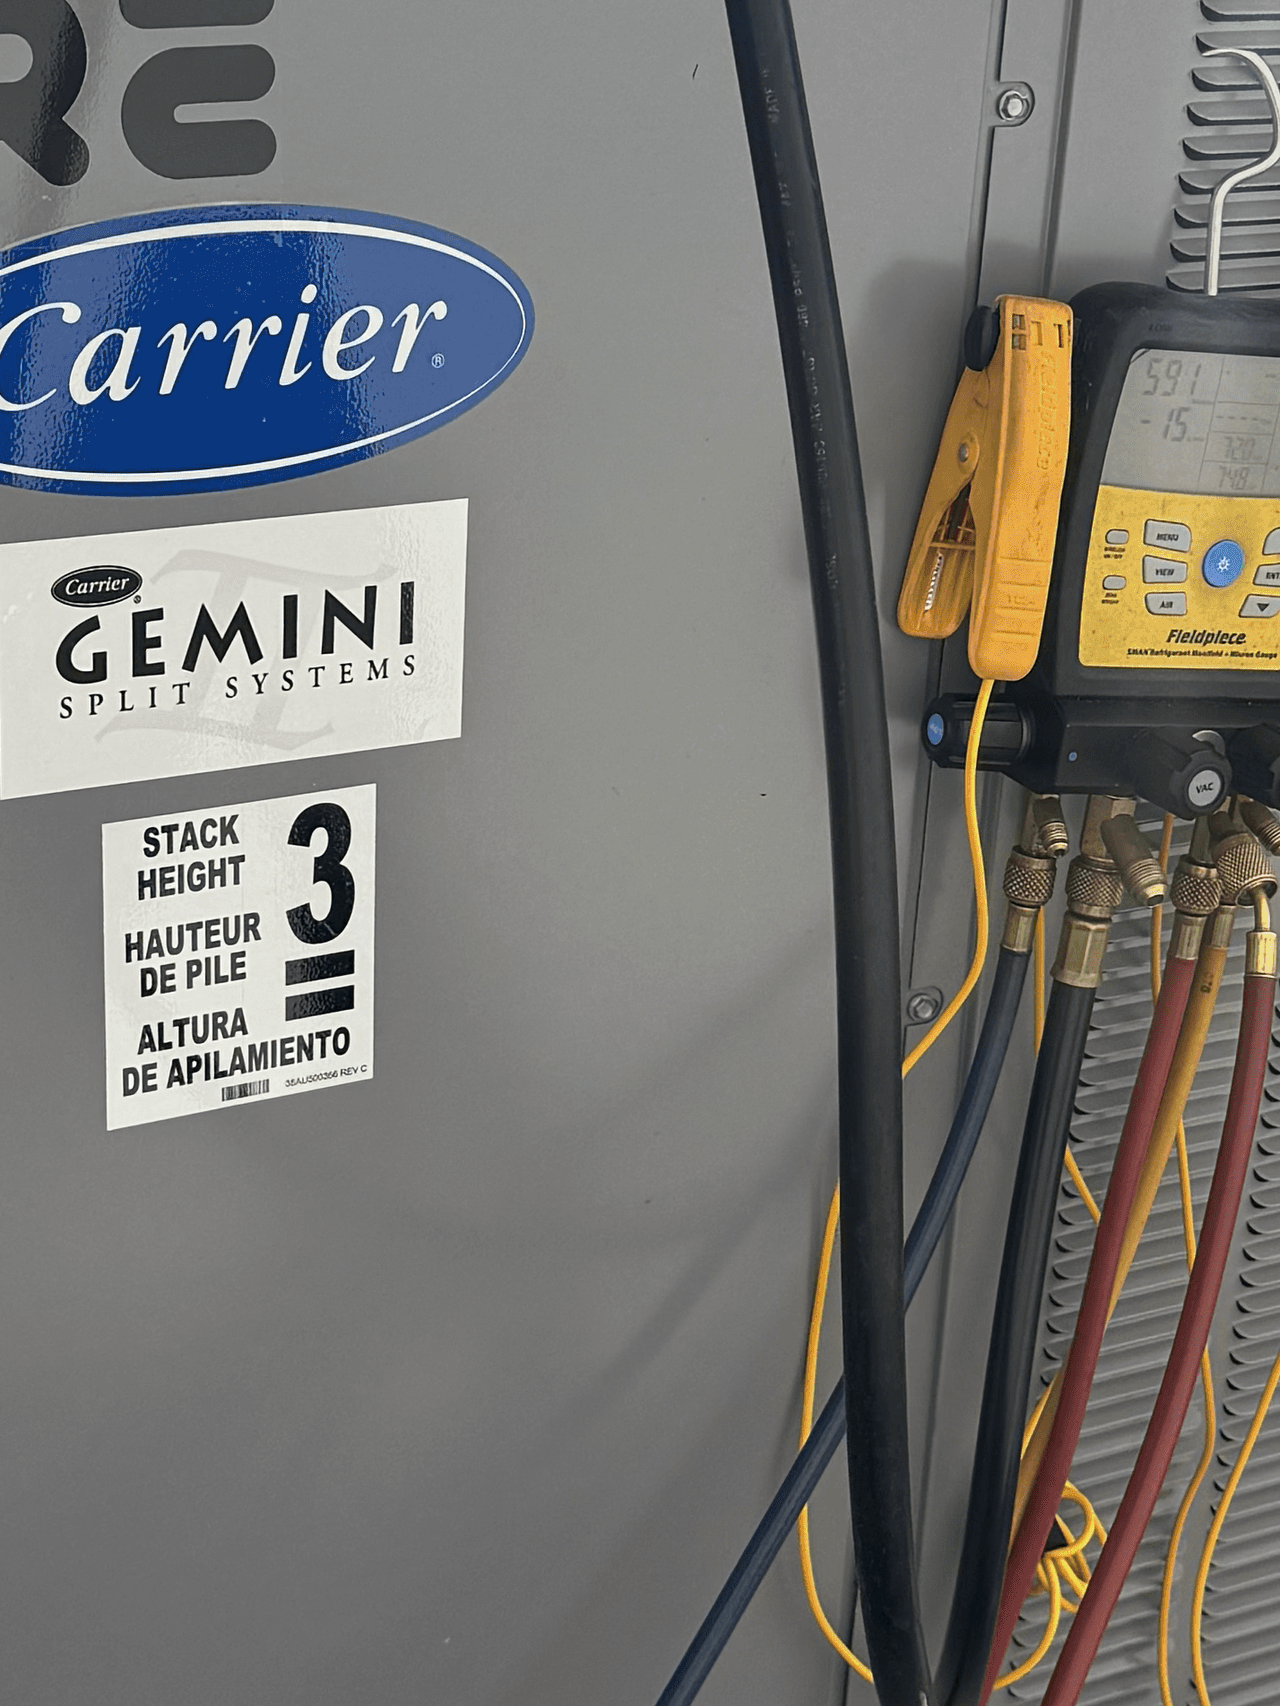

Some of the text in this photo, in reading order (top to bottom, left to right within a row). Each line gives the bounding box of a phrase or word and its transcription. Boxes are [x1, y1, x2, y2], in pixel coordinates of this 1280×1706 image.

[1156, 532, 1179, 542] MENU
[64, 574, 130, 597] Carrier
[1155, 568, 1175, 577] VIEW
[55, 580, 415, 685] GEMINI
[1166, 629, 1245, 646] Fieldpiece
[58, 653, 416, 719] SPLIT SYSTEMS
[1194, 781, 1216, 794] VAC
[142, 814, 240, 858] STACK
[137, 854, 246, 901] HEIGHT
[285, 802, 356, 945] 3
[124, 911, 262, 964] HAUTEUR
[140, 950, 247, 998] DE PILE
[137, 1006, 249, 1056] ALTURA
[122, 1026, 351, 1098] DE APILAMIENTO
[340, 1066, 359, 1077] REV
